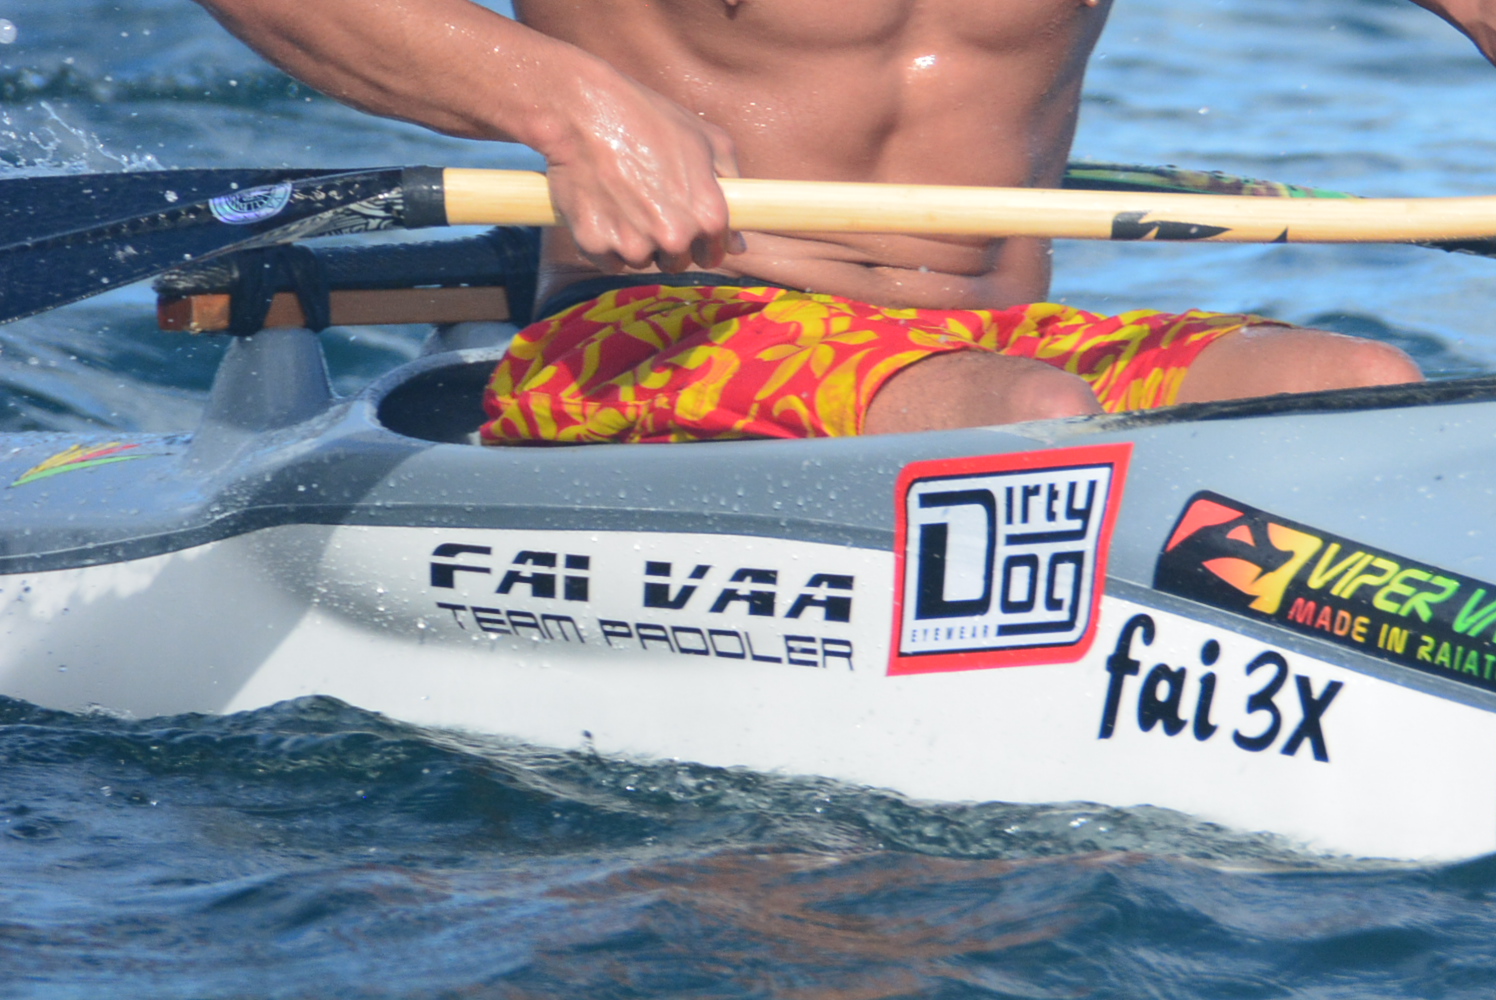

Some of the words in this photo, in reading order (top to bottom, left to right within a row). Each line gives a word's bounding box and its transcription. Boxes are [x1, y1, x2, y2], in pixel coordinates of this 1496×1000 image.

[430, 543, 591, 602] FAI
[643, 560, 855, 623] VAA
[1307, 543, 1461, 623] VIPER
[437, 602, 586, 645] TEAM
[597, 617, 855, 671] PADDLER
[1287, 597, 1371, 643] MADE
[1378, 623, 1407, 654] IN
